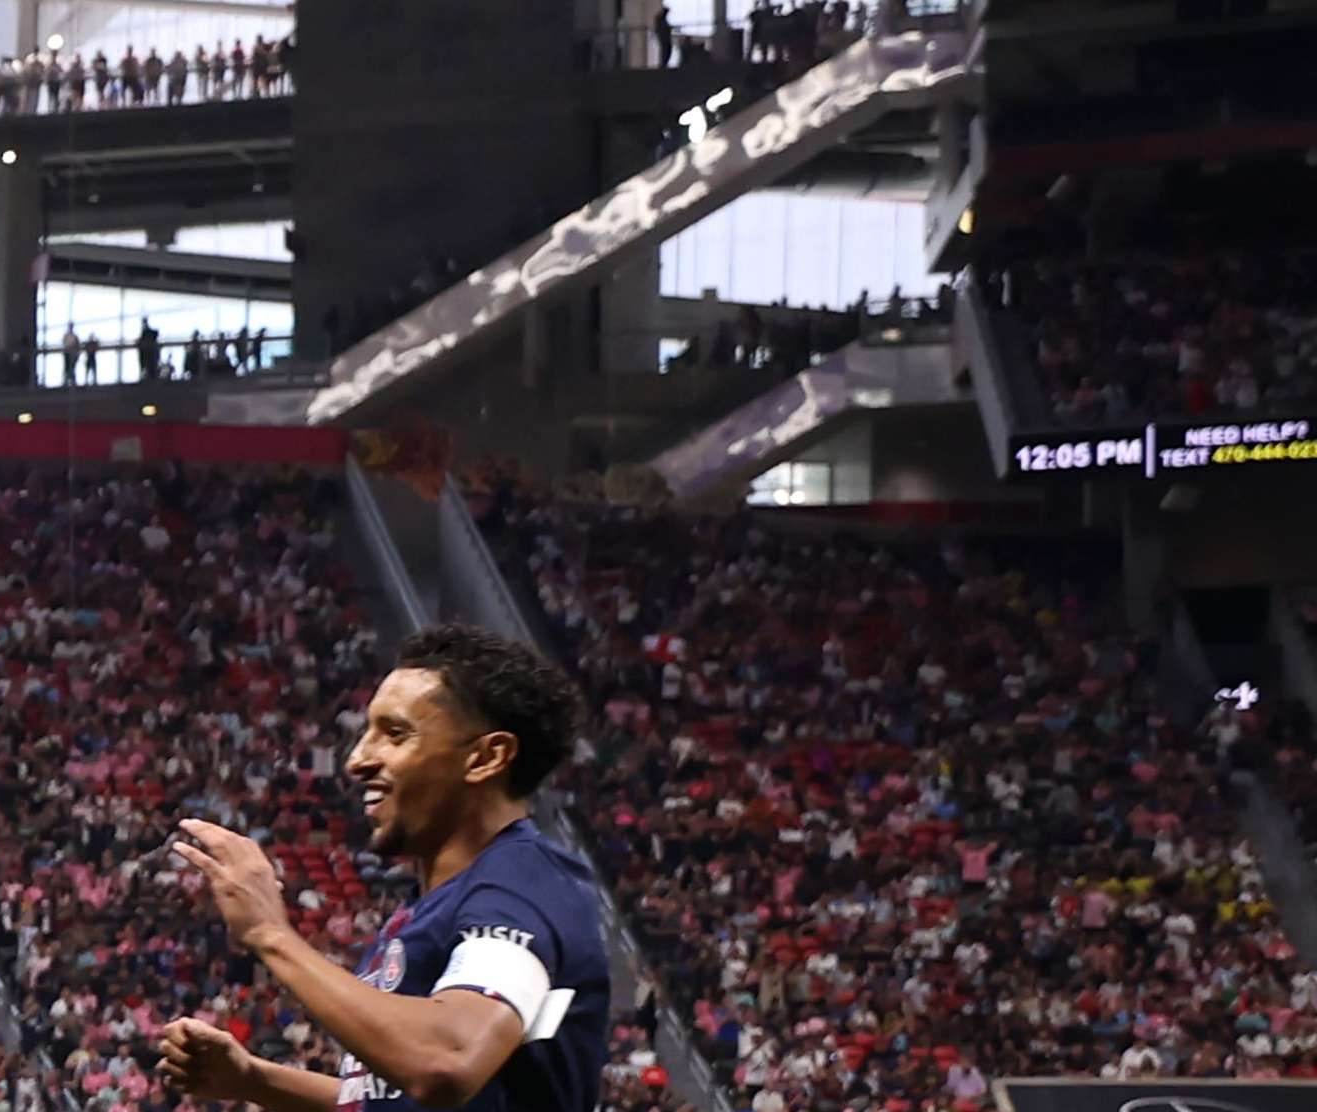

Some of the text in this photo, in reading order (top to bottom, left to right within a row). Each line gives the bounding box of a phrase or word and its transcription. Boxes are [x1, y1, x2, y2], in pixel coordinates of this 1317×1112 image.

[1185, 425, 1241, 446] NEED
[1015, 437, 1142, 471] 12:05 PM
[1159, 447, 1210, 467] TEXT
